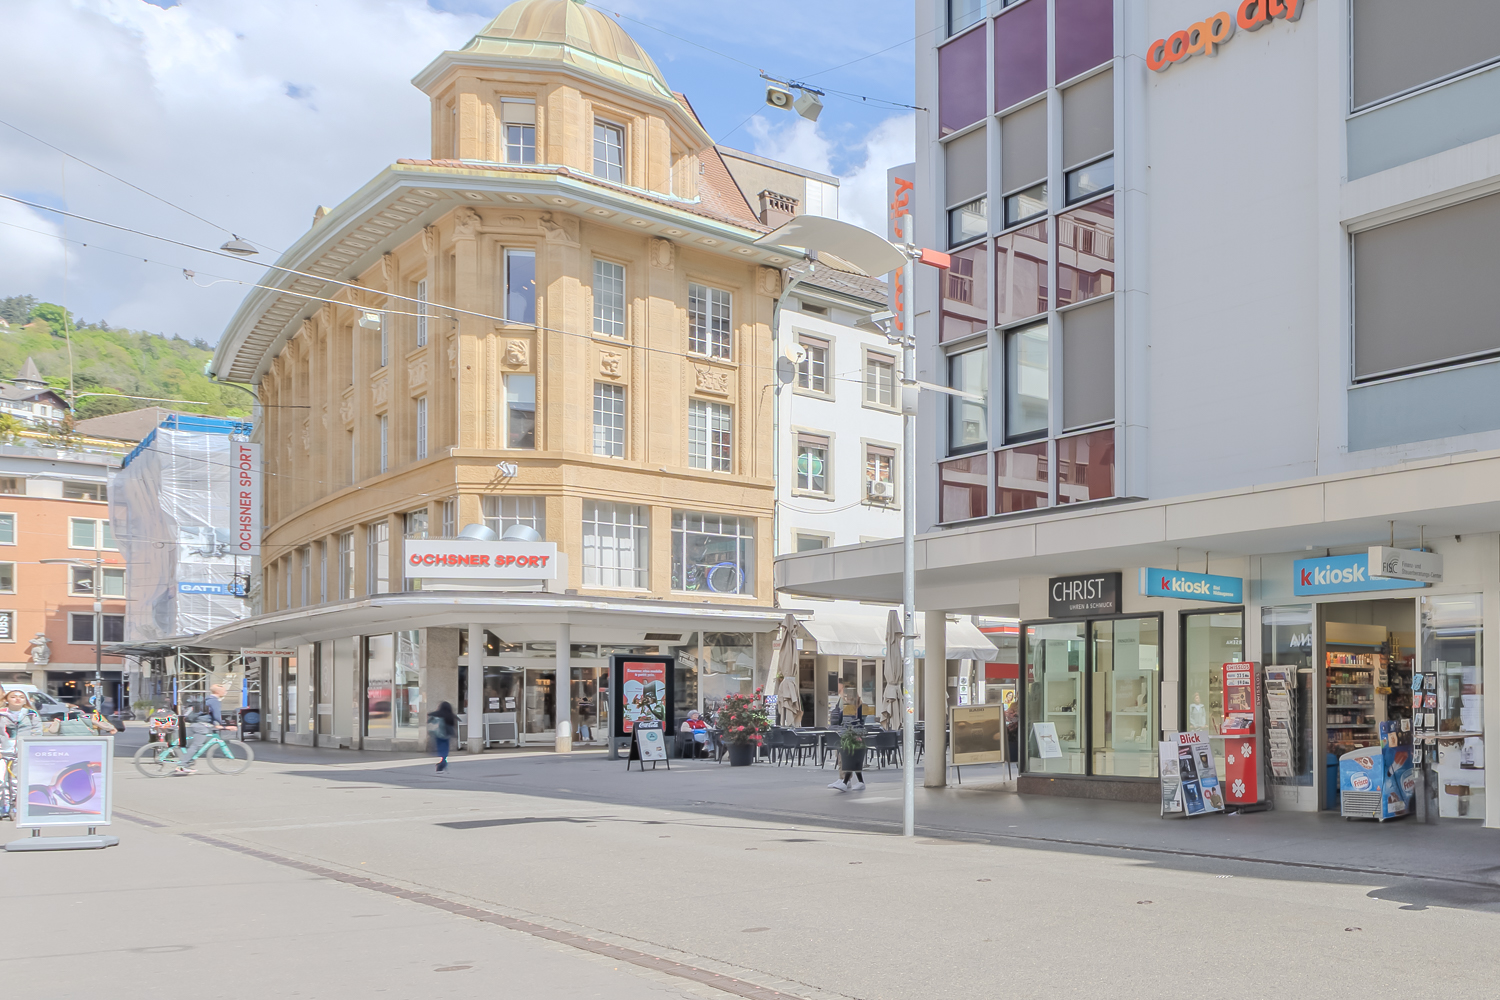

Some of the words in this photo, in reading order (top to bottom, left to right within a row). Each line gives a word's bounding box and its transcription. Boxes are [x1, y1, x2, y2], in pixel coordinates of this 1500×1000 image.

[1146, 11, 1232, 72] coop
[239, 446, 252, 487] SPORT
[239, 492, 252, 551] OCHSNER
[410, 553, 490, 566] OCHSNER
[495, 555, 550, 567] SPORT
[1382, 561, 1398, 574] FISC
[1300, 568, 1313, 586] k
[1314, 563, 1366, 586] kiosk
[180, 584, 222, 593] GATTI
[1052, 578, 1105, 602] CHRIST
[1161, 576, 1170, 591] k
[1172, 577, 1210, 595] kiosk
[1069, 603, 1085, 611] UHREN
[1180, 733, 1201, 744] Blick
[1353, 778, 1369, 787] Frisco
